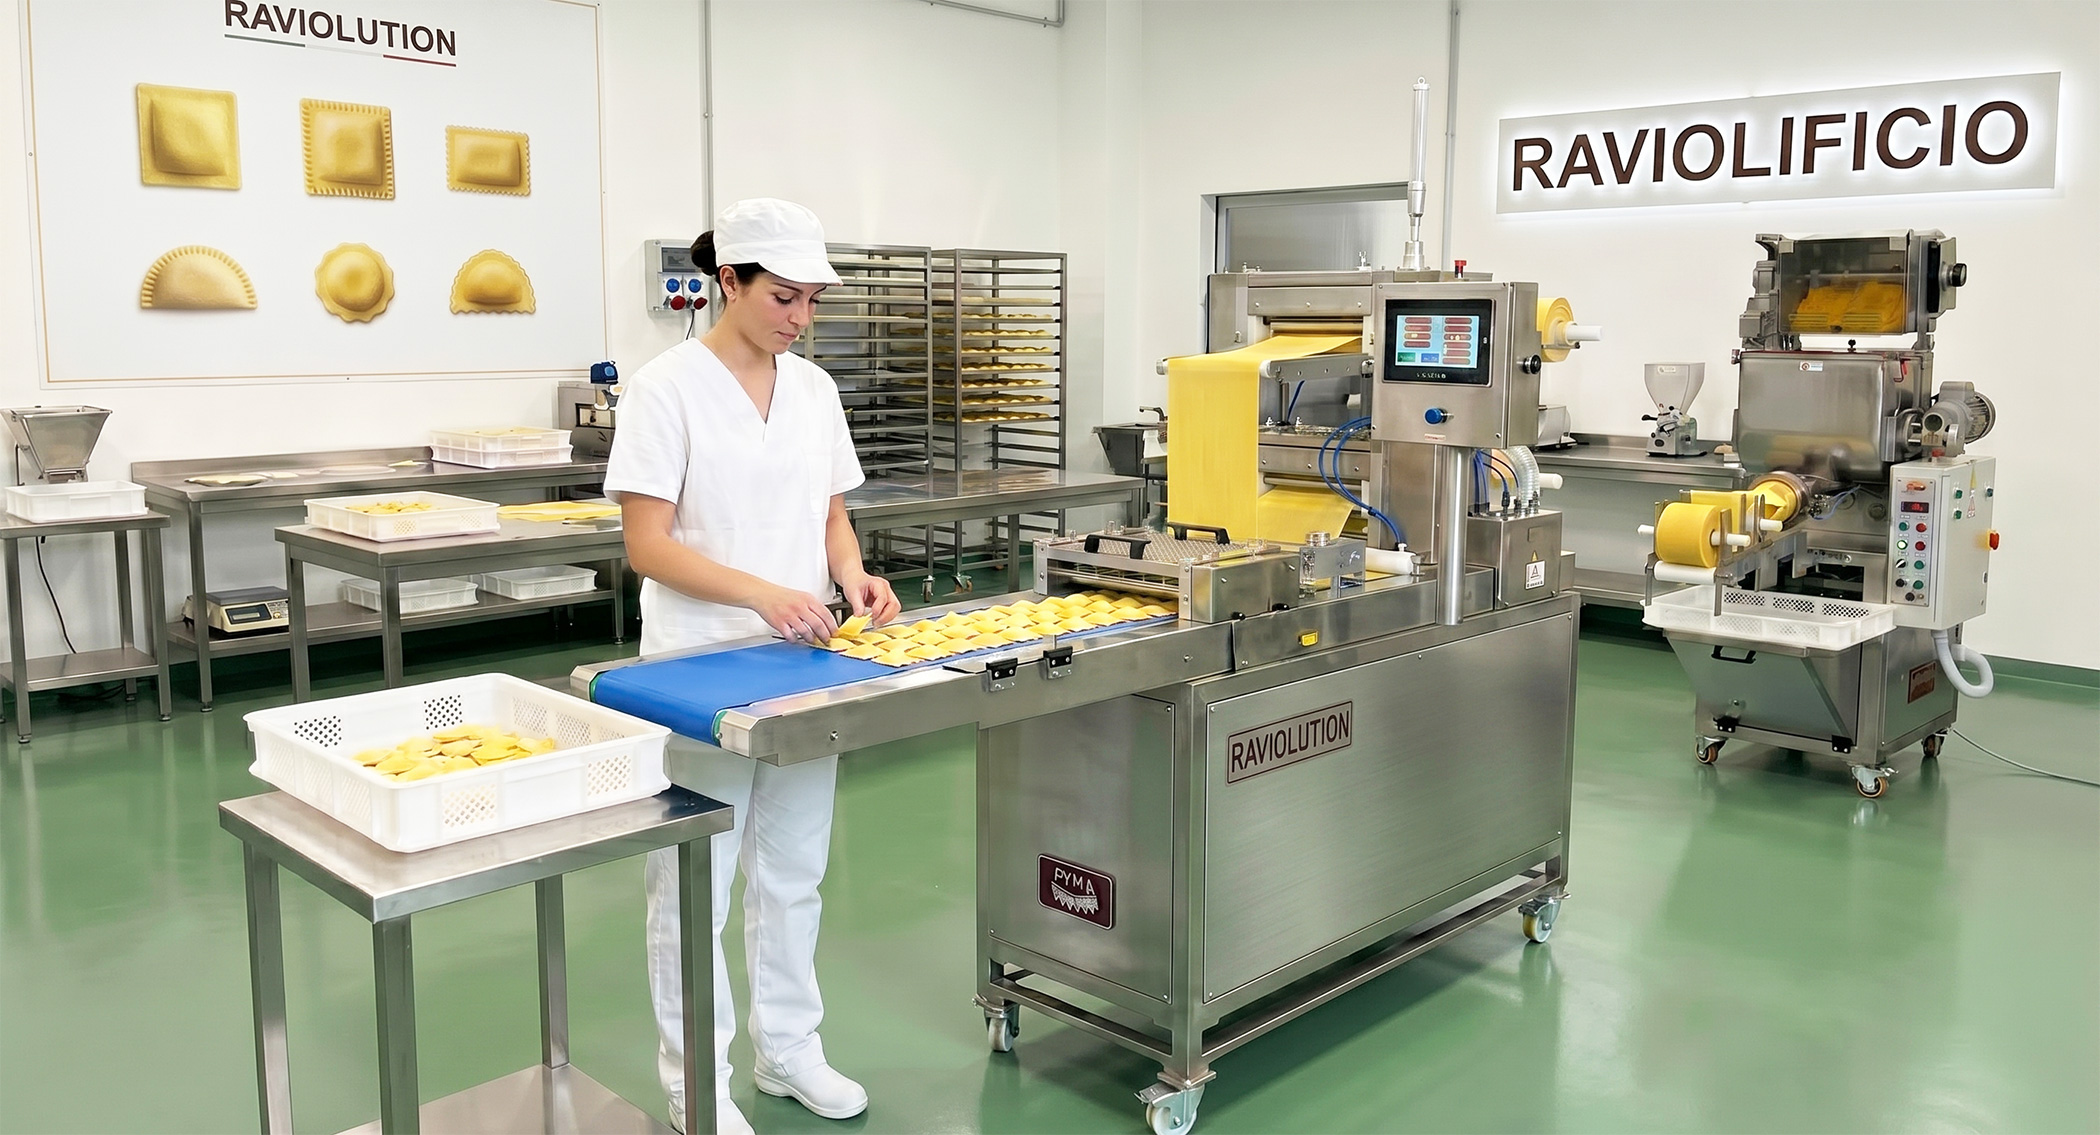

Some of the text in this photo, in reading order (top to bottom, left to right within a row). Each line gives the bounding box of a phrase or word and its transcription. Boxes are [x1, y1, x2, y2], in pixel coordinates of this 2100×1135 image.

[225, 0, 456, 56] RAVIOLUTION
[1513, 101, 2029, 191] RAVIOLIFICIO
[1231, 710, 1349, 773] RAVIOLUTION
[1054, 867, 1095, 895] PYMA
